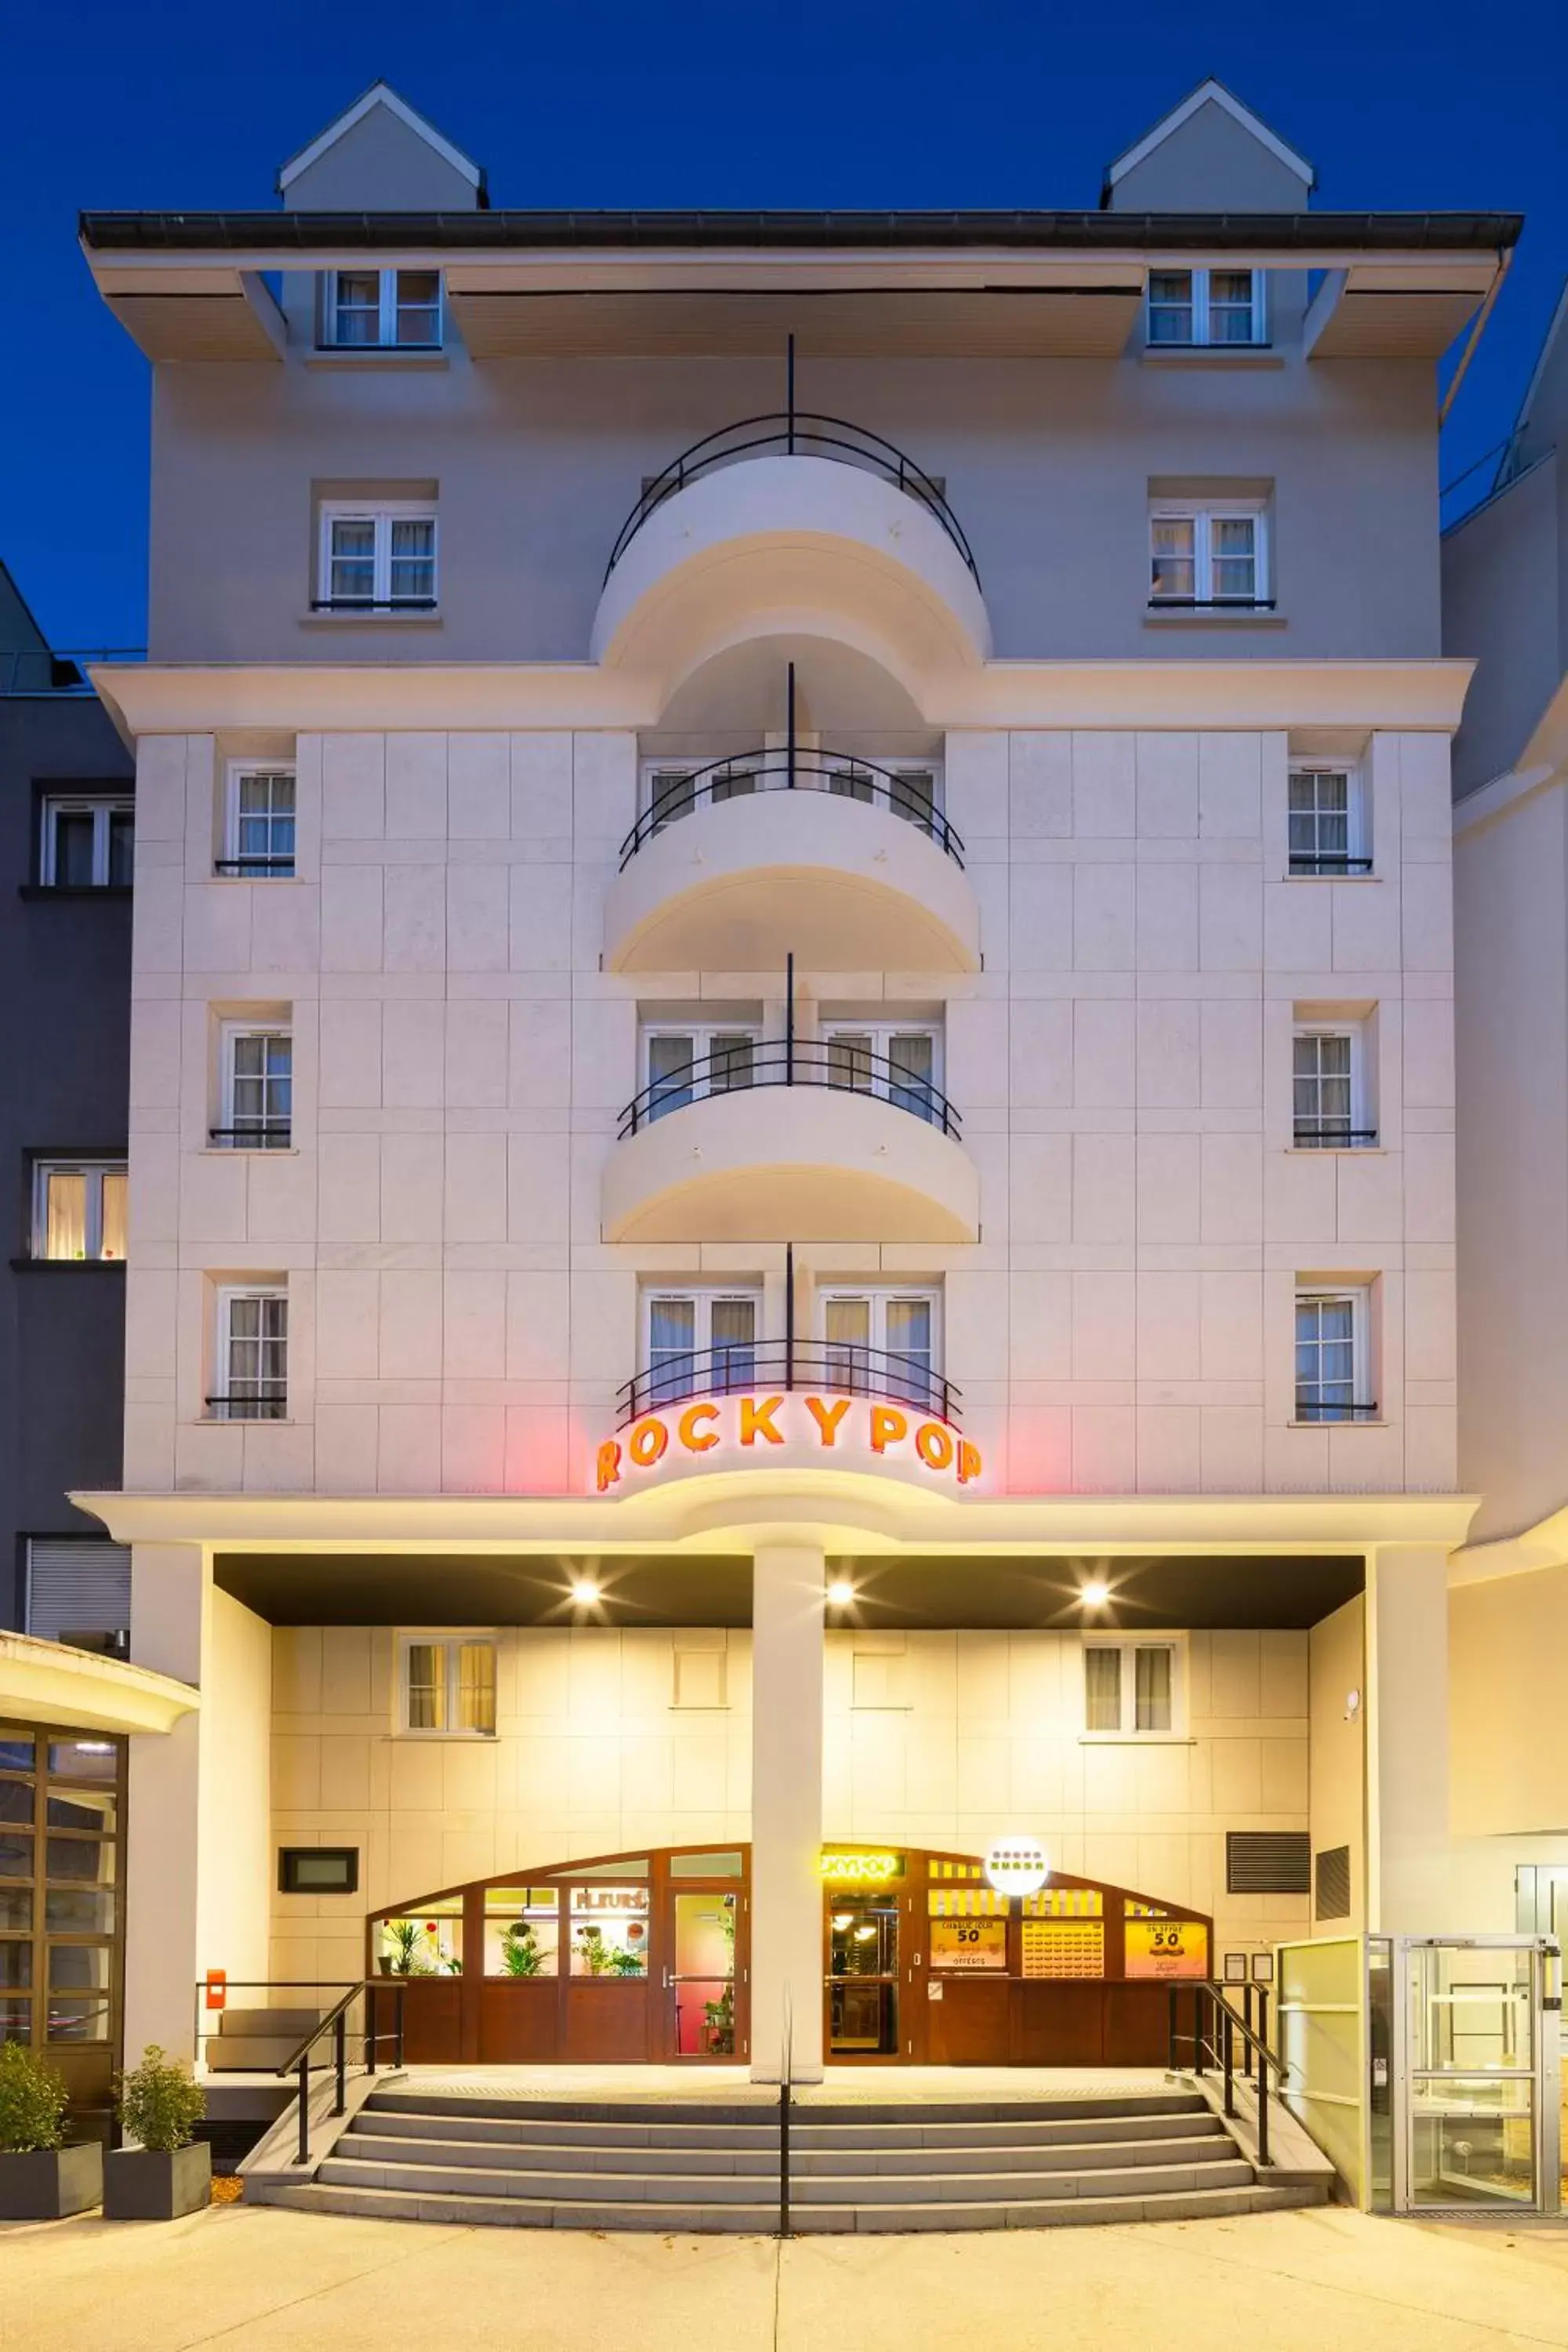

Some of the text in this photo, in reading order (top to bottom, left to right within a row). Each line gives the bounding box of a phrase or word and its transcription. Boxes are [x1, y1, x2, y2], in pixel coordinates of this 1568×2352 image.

[597, 1396, 982, 1490] ROCKYPOP
[957, 1929, 980, 1943] 50
[1155, 1933, 1178, 1946] 50
